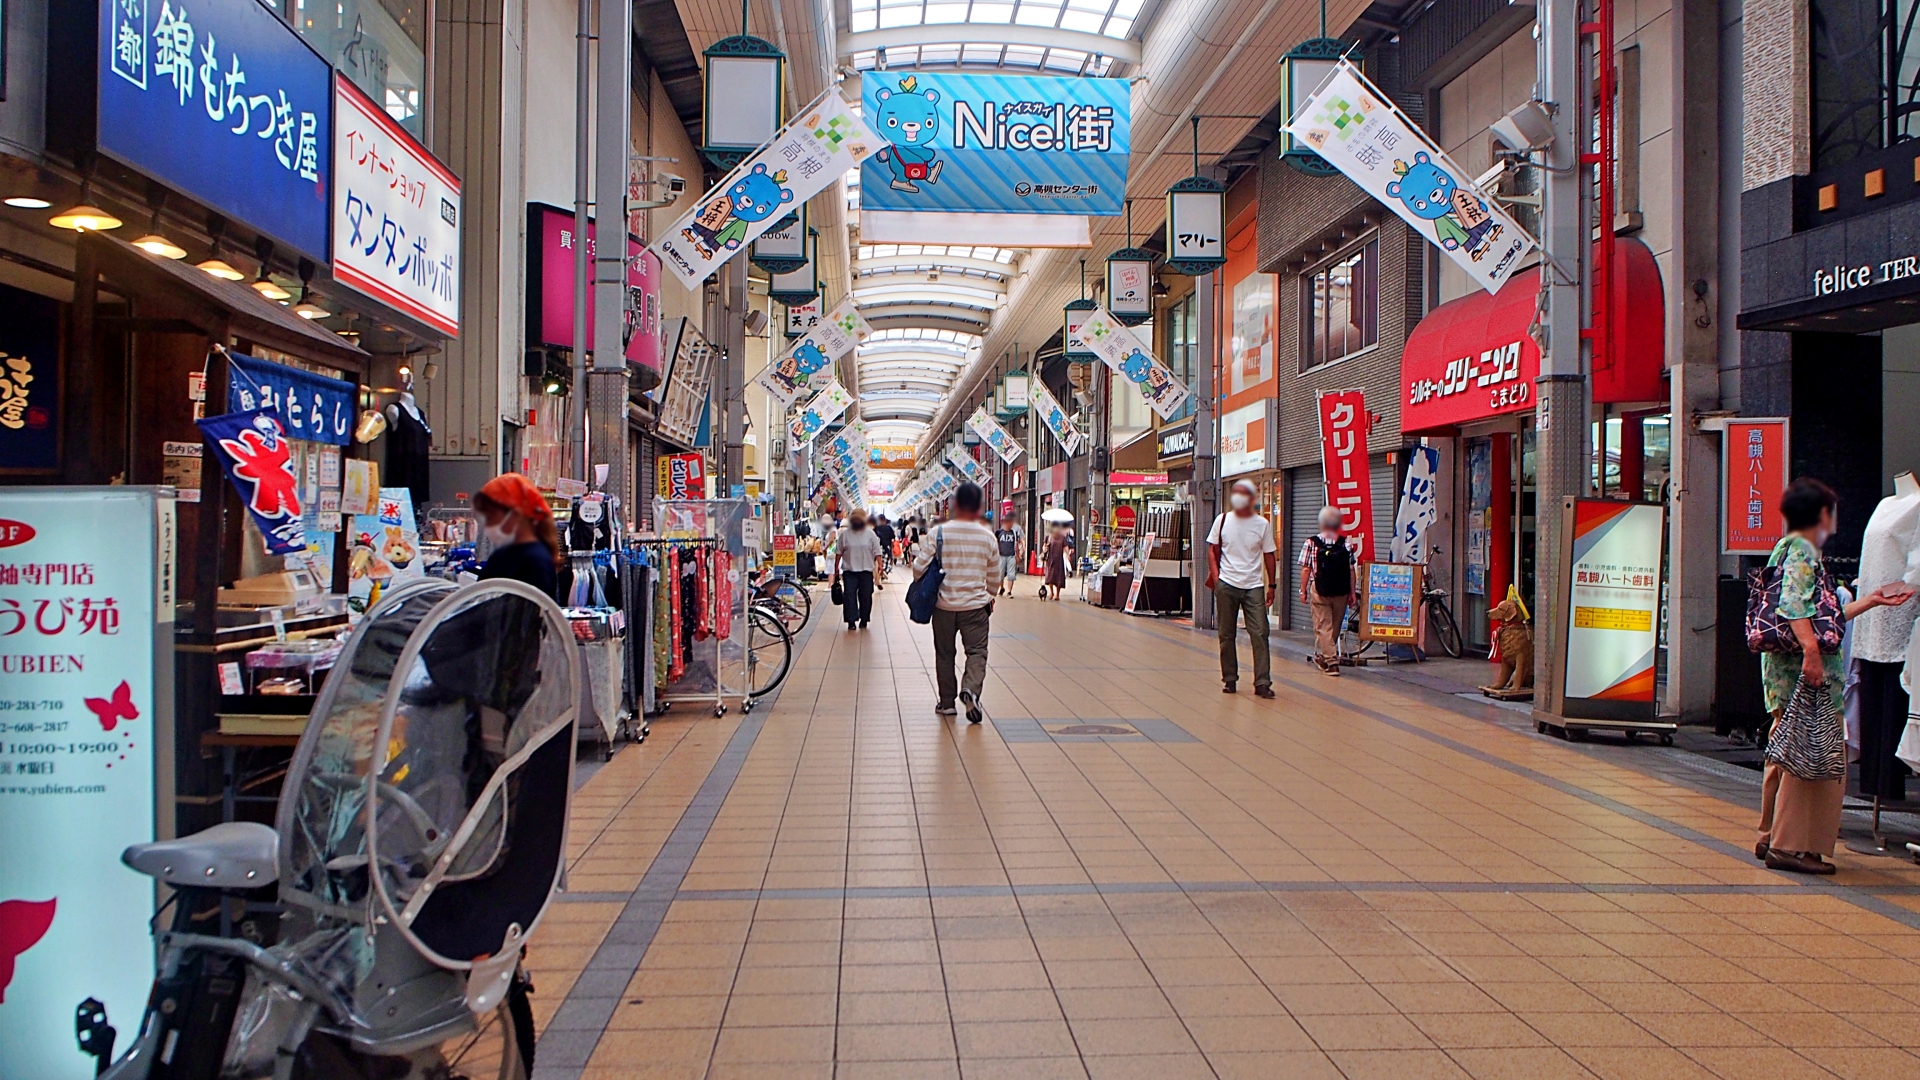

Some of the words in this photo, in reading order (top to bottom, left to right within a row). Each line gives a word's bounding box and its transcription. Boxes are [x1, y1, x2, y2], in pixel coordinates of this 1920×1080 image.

[152, 0, 318, 184] 錦もちつき屋
[1003, 101, 1054, 118] ナイスガイ
[953, 100, 1115, 152] Nice!街
[346, 130, 427, 210] インナーショップ
[780, 139, 824, 180] 高槻
[1033, 184, 1098, 194] 高槻センター街
[702, 200, 727, 226] 王将
[345, 188, 453, 302] タンタンポッポ
[1178, 233, 1218, 248] マリー
[1813, 265, 1871, 297] felice
[1880, 256, 1920, 282] TER
[1409, 341, 1523, 405] シルキーのクリーニング
[1489, 382, 1528, 408] こまどり
[670, 459, 687, 499] ガラス
[1747, 429, 1763, 529] 高槻ハート歯科
[1576, 571, 1654, 587] 高槻ハート歯科
[2, 654, 85, 673] UBIEN
